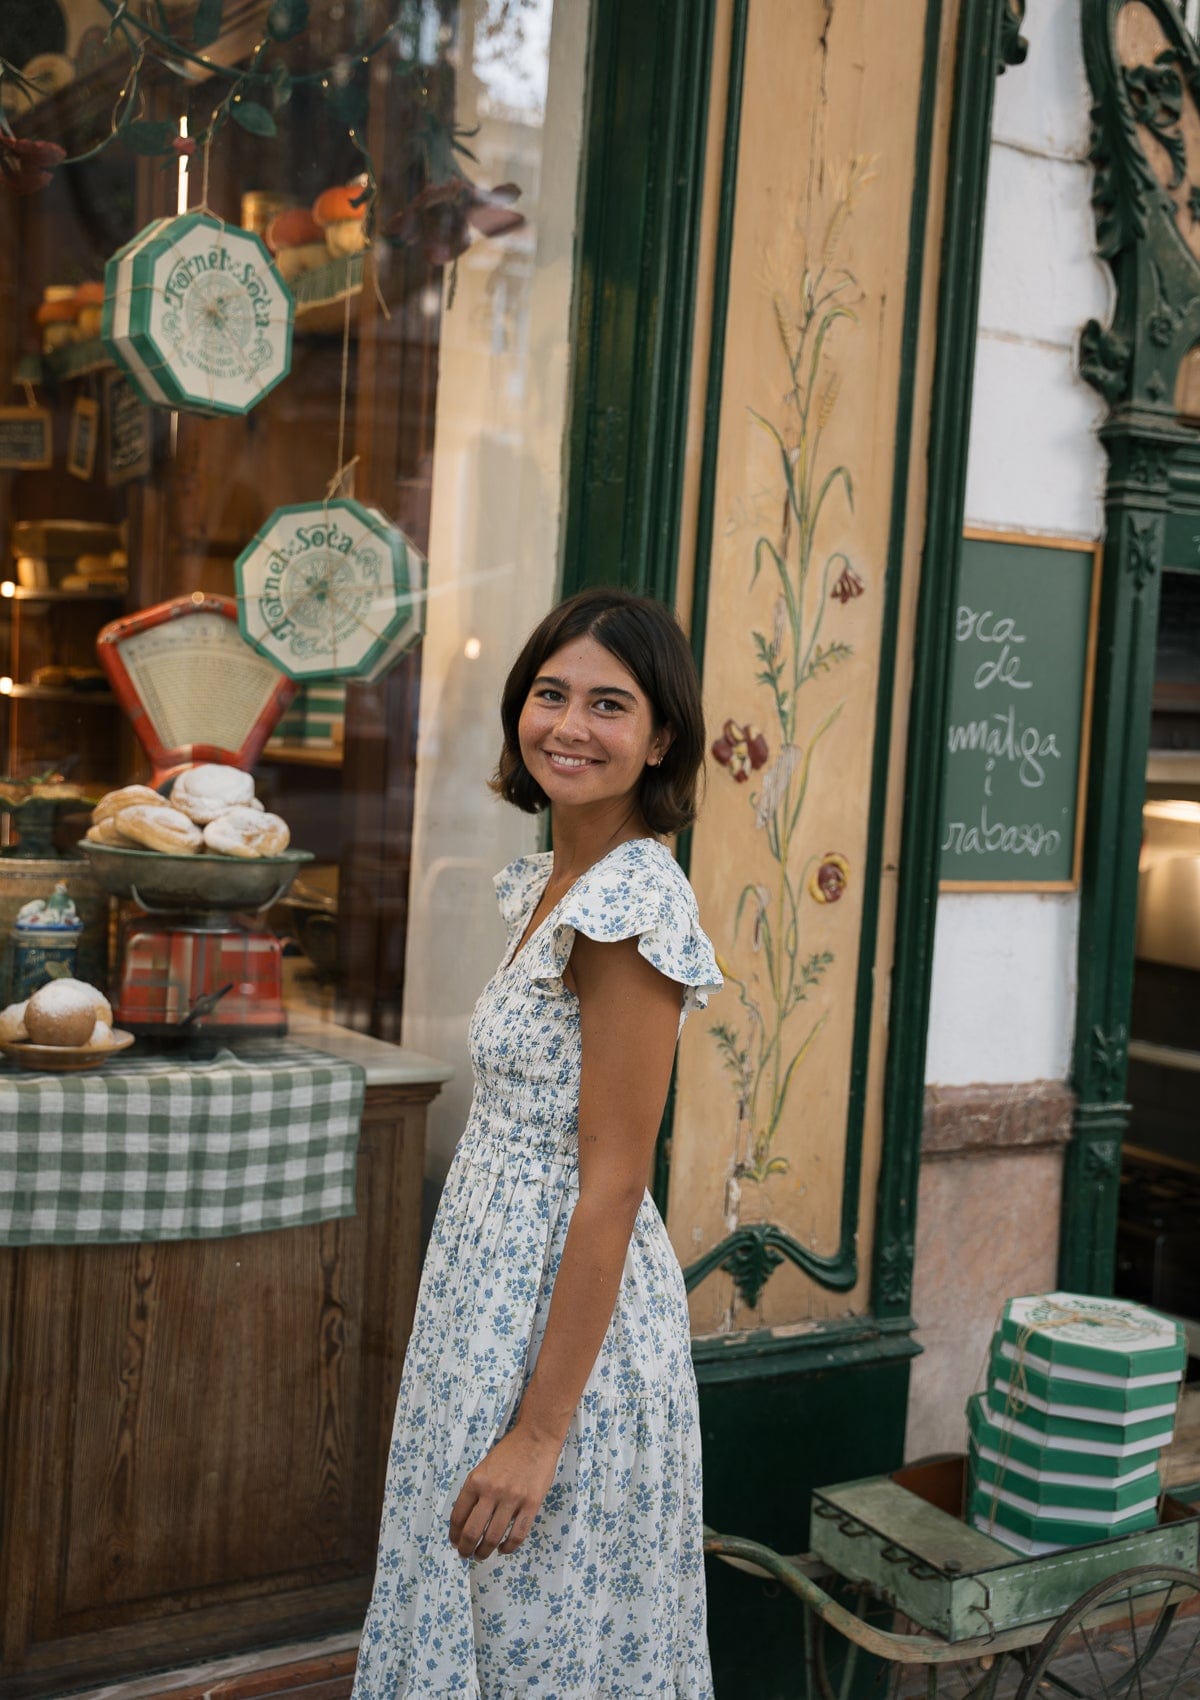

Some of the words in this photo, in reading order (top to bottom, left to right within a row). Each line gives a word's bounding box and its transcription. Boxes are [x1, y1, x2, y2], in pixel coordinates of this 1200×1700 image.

[955, 605, 1027, 643] oca
[974, 645, 1034, 690] de
[984, 757, 996, 797] i
